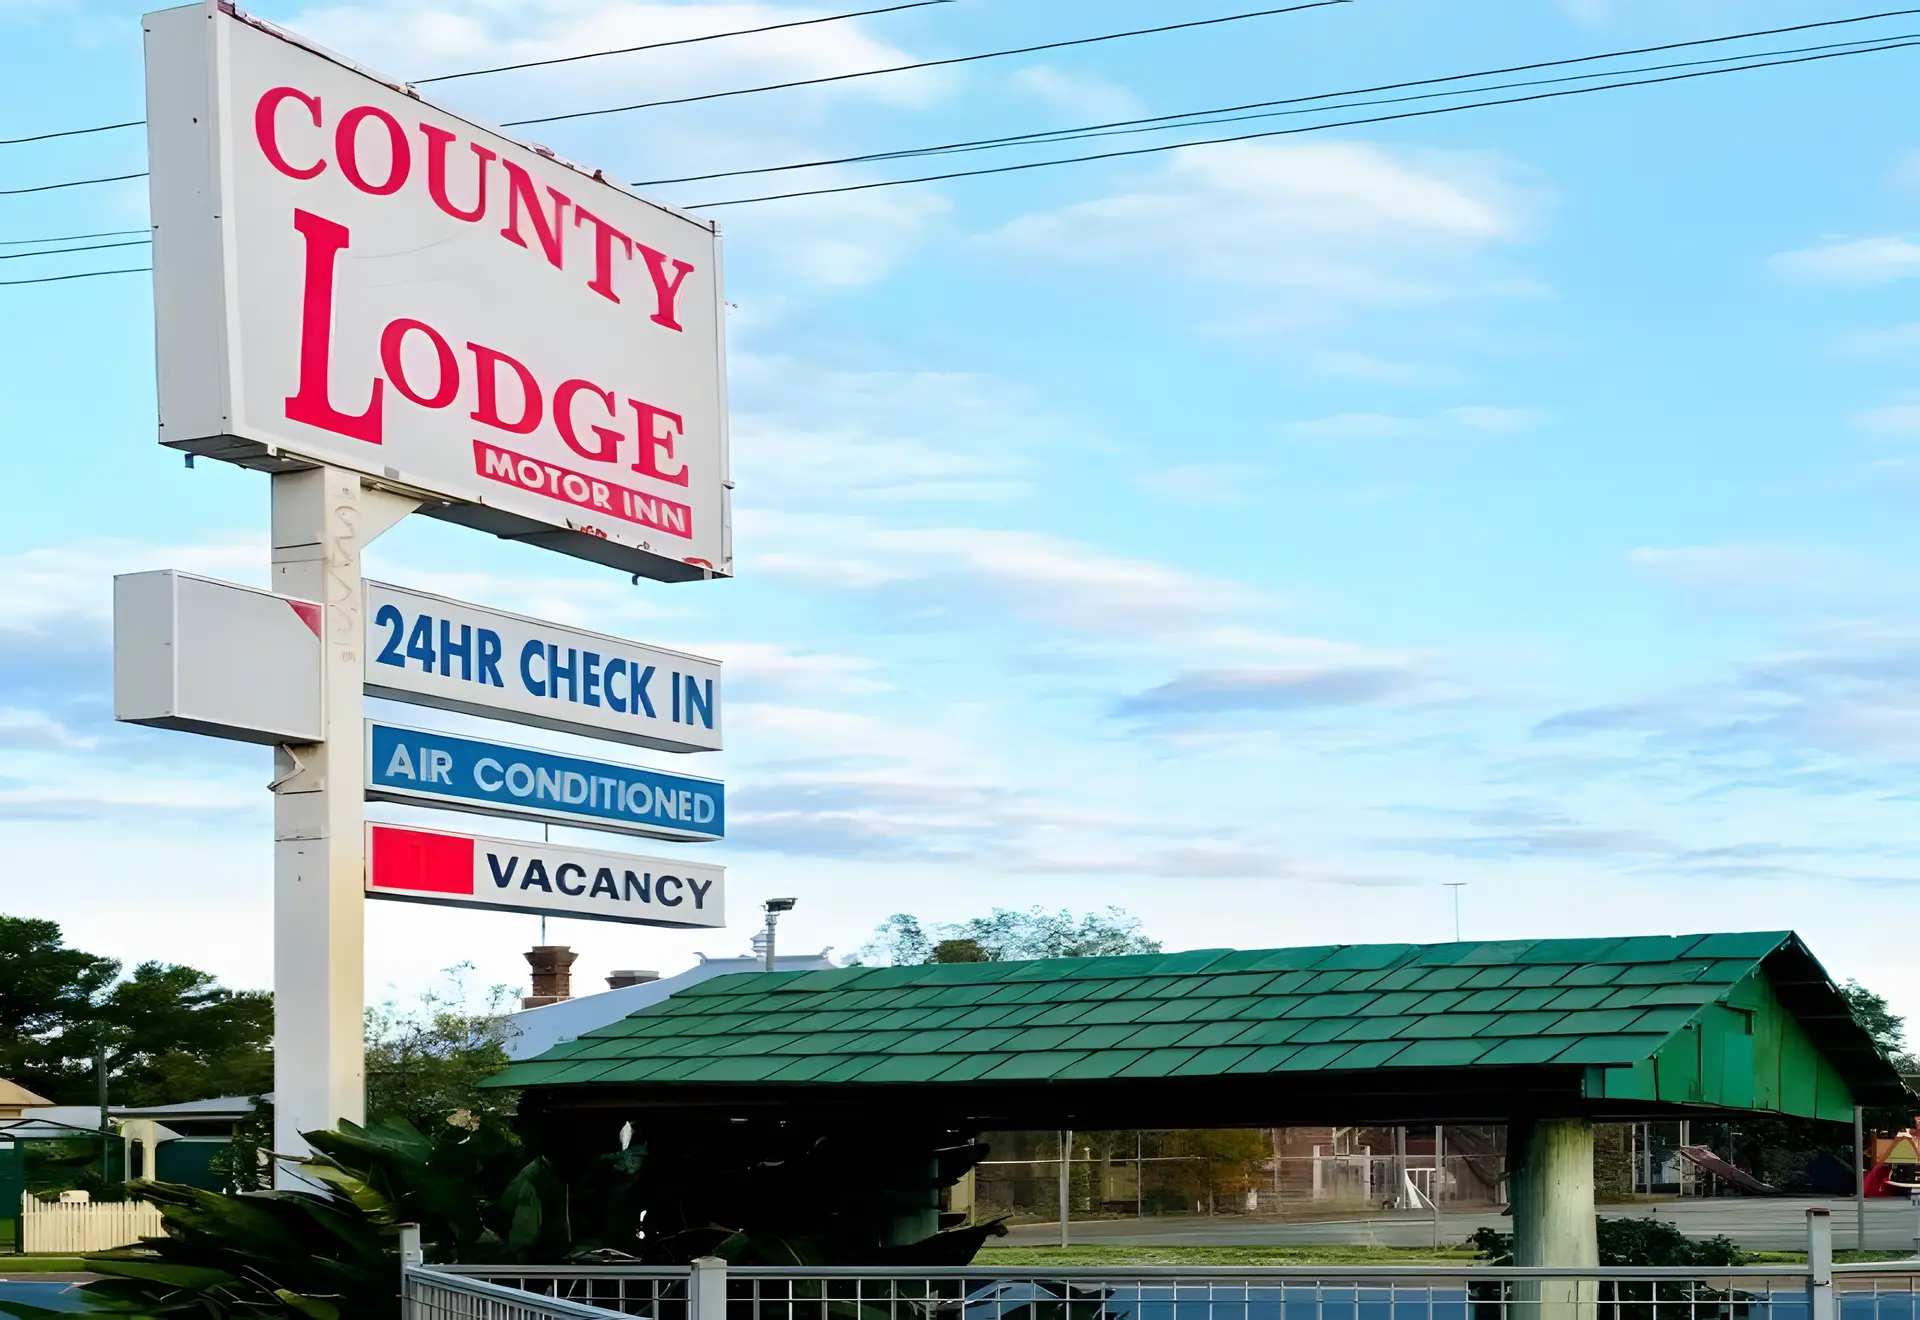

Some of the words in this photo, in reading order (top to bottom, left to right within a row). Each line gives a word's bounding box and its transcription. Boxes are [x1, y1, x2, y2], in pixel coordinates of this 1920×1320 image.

[255, 86, 695, 332] COUNTY
[285, 207, 690, 487] LODGE
[485, 447, 613, 510] MOTOR
[622, 489, 686, 533] INN
[374, 604, 504, 688] 24HR
[519, 639, 657, 719] CHECK
[672, 671, 714, 730] IN
[385, 743, 454, 786] AIR
[473, 757, 716, 824] CONDITIONED
[486, 853, 713, 911] VACANCY
